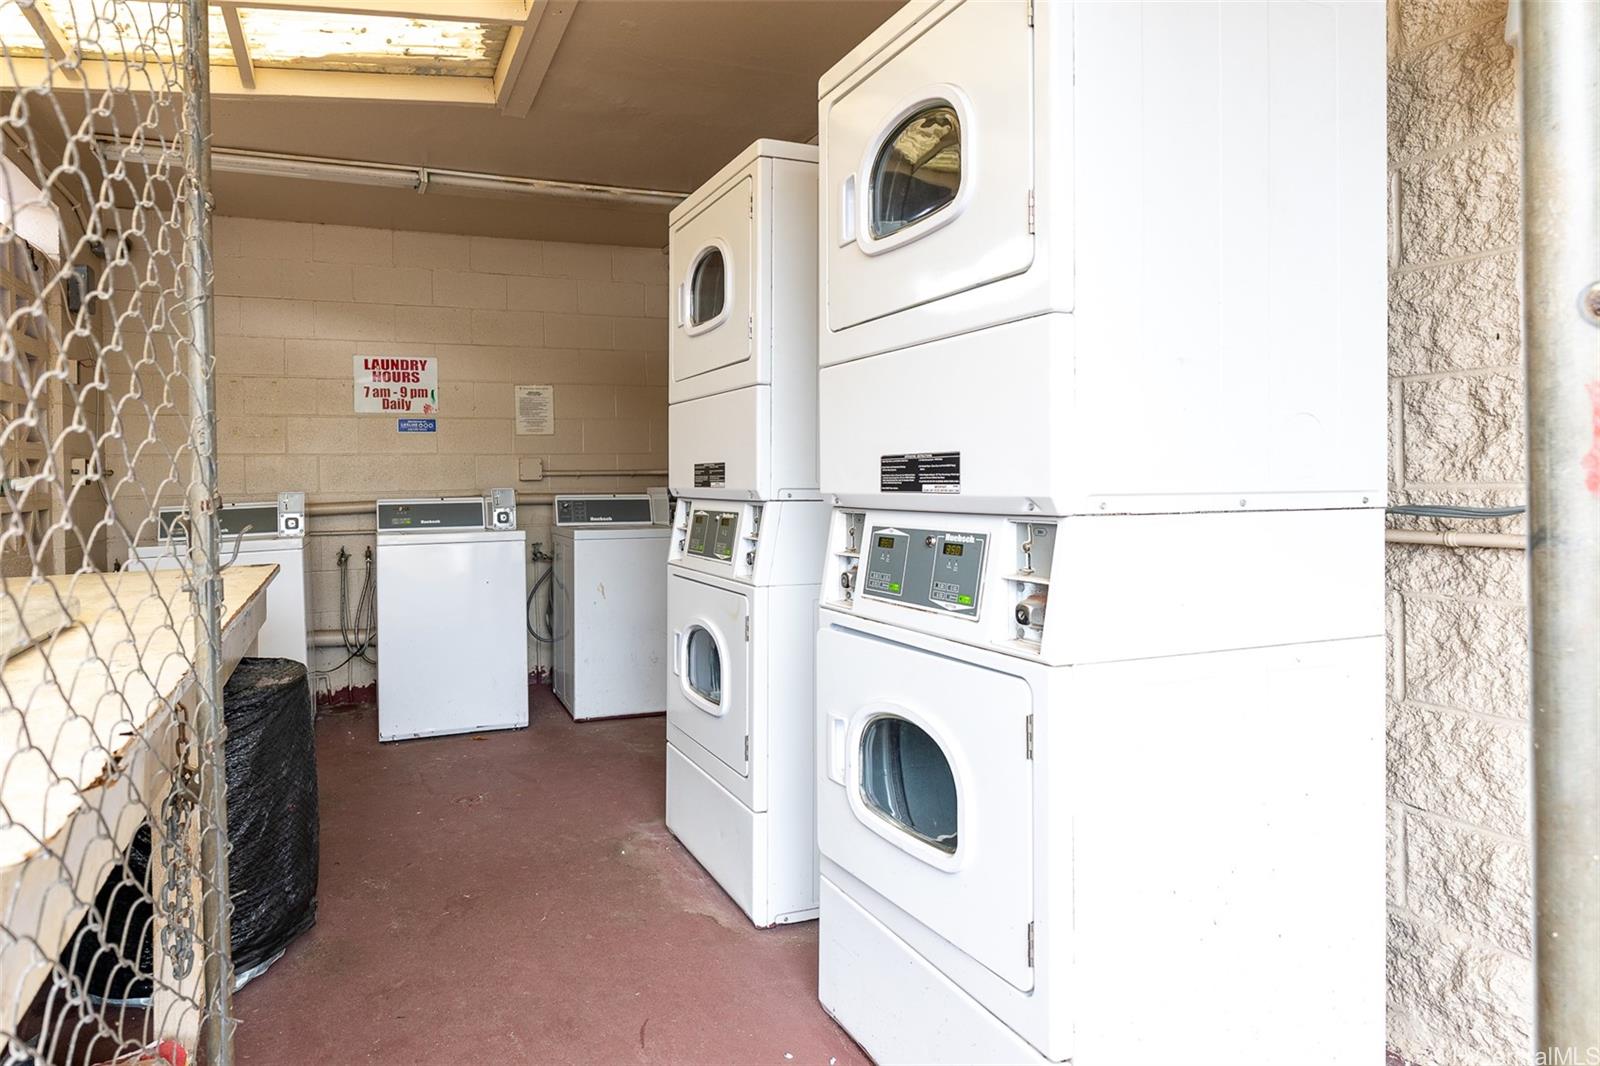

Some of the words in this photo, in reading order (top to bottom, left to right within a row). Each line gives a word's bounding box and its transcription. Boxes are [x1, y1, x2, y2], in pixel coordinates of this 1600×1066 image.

[364, 358, 428, 371] LAUNDRY
[372, 371, 420, 383] HOURS
[363, 386, 370, 398] 7
[372, 388, 391, 398] am
[400, 386, 408, 398] 9
[410, 388, 428, 399] pm
[382, 398, 412, 411] Daily
